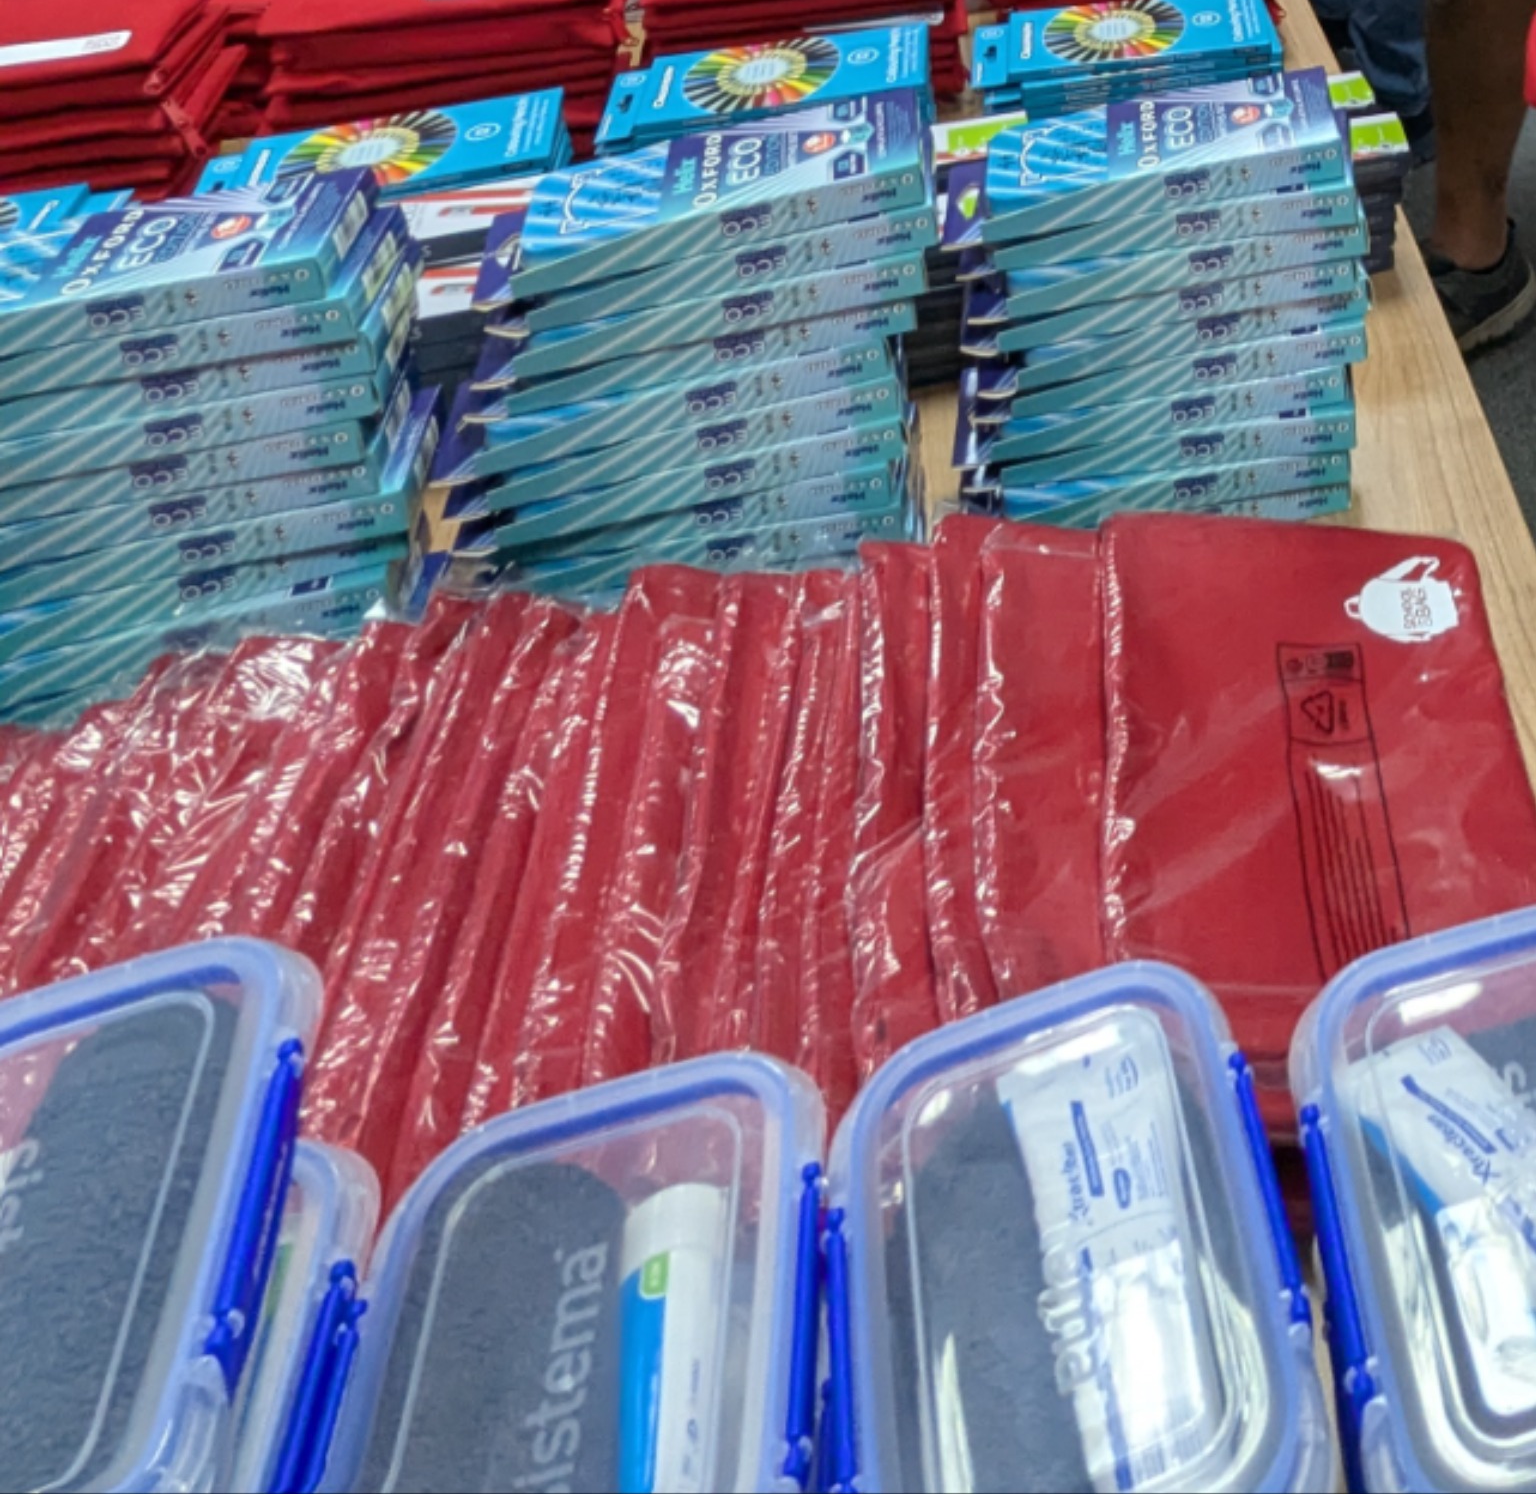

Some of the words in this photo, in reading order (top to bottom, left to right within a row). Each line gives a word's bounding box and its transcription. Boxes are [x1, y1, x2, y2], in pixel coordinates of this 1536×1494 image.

[1137, 99, 1161, 169] OXFORD
[1165, 105, 1195, 150] ECO
[672, 156, 698, 195] Helix
[693, 132, 722, 208] OXFORD
[728, 137, 763, 187] ECO
[61, 209, 145, 295] OXFORD
[112, 216, 178, 272] ECO
